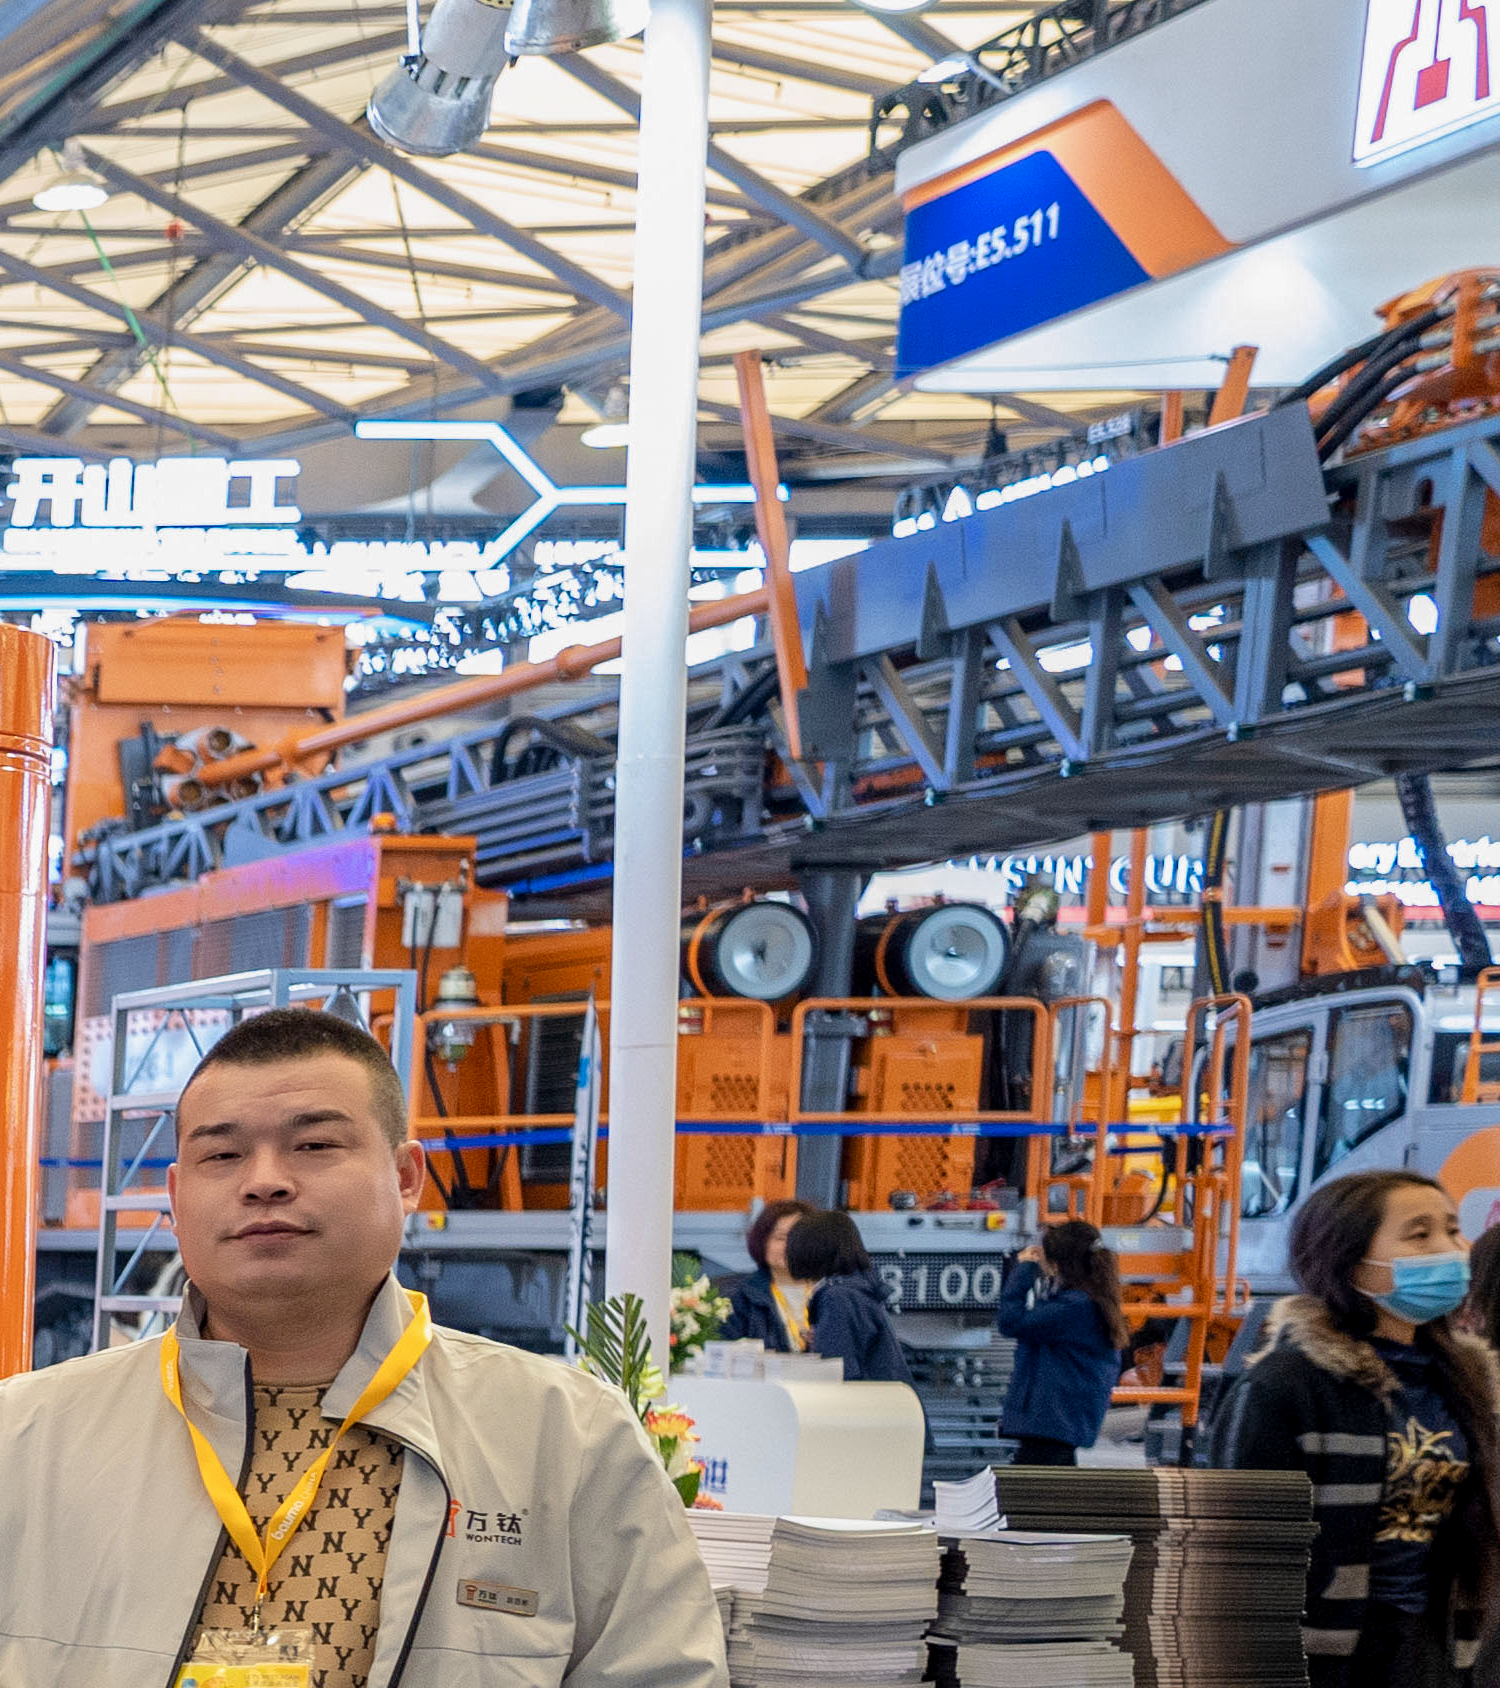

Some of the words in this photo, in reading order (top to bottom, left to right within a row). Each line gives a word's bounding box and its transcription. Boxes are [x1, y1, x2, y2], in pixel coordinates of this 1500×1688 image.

[260, 1388, 284, 1407] Y
[288, 1409, 308, 1429] Y
[308, 1429, 332, 1448] N
[261, 1431, 280, 1450] Y
[283, 1453, 300, 1471] Y
[334, 1449, 360, 1469] N
[360, 1465, 378, 1483] Y
[257, 1474, 275, 1492] Y
[327, 1489, 350, 1508] N
[380, 1484, 400, 1507] Y
[354, 1509, 372, 1528] Y
[466, 1510, 522, 1535] 万钛
[322, 1532, 344, 1553] N
[465, 1533, 522, 1546] WONTECH
[290, 1556, 313, 1576] N
[348, 1554, 365, 1572] Y
[214, 1581, 239, 1604] N
[317, 1577, 338, 1598] N
[284, 1601, 307, 1621] N
[341, 1599, 360, 1620] Y
[313, 1623, 332, 1644] N
[335, 1647, 353, 1670] Y
